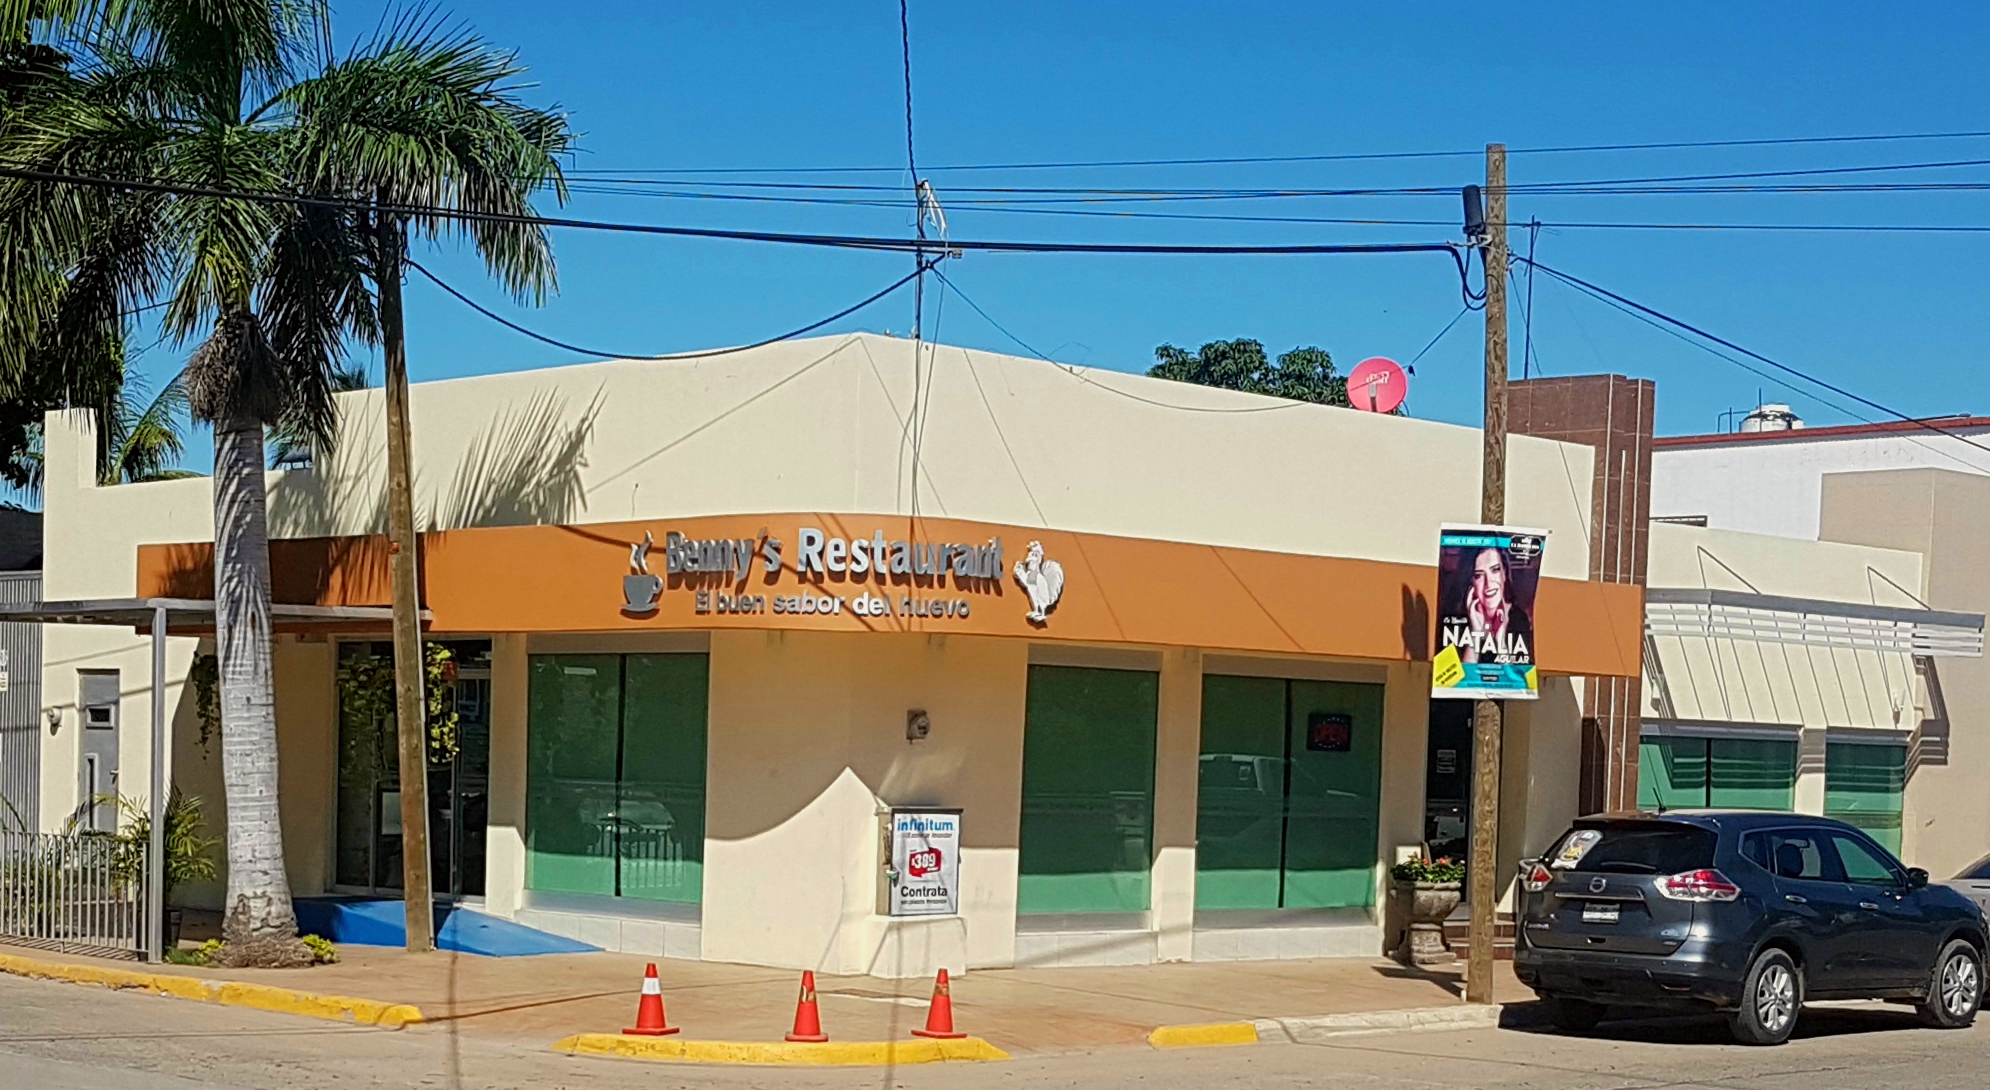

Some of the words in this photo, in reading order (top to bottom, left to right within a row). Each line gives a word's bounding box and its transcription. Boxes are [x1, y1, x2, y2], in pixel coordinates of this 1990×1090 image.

[666, 527, 783, 580] Benny's
[796, 527, 1004, 579] Restaurant
[695, 590, 711, 612] El
[717, 590, 767, 613] buen
[773, 589, 844, 614] sabor
[852, 592, 891, 616] del
[901, 593, 970, 617] huevo
[1442, 625, 1529, 655] NATALIA
[1493, 654, 1530, 664] AGUILAR
[897, 816, 953, 832] infinitum
[900, 885, 948, 897] Contrata
